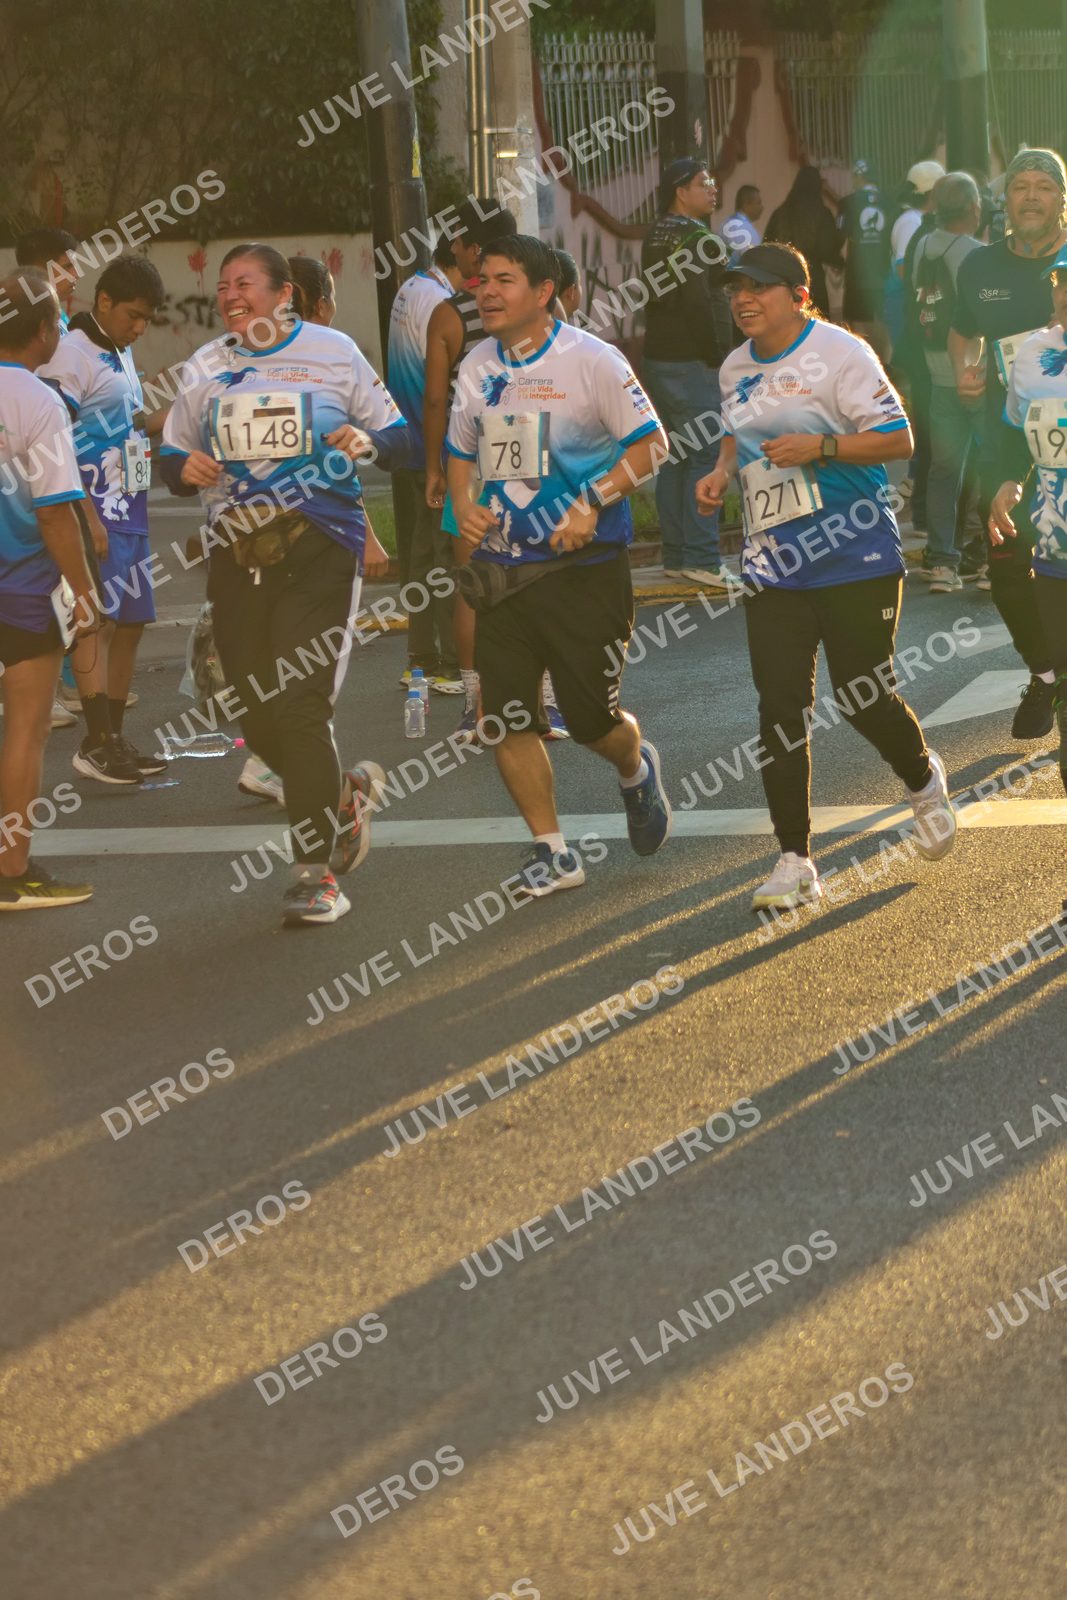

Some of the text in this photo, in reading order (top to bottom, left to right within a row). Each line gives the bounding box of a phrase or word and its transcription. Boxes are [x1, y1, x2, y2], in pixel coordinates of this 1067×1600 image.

[518, 377, 553, 386] Carrera
[537, 385, 553, 393] Vida
[529, 392, 566, 401] Integridad
[223, 419, 299, 452] 1148
[491, 440, 522, 470] 78
[745, 478, 801, 524] 1271
